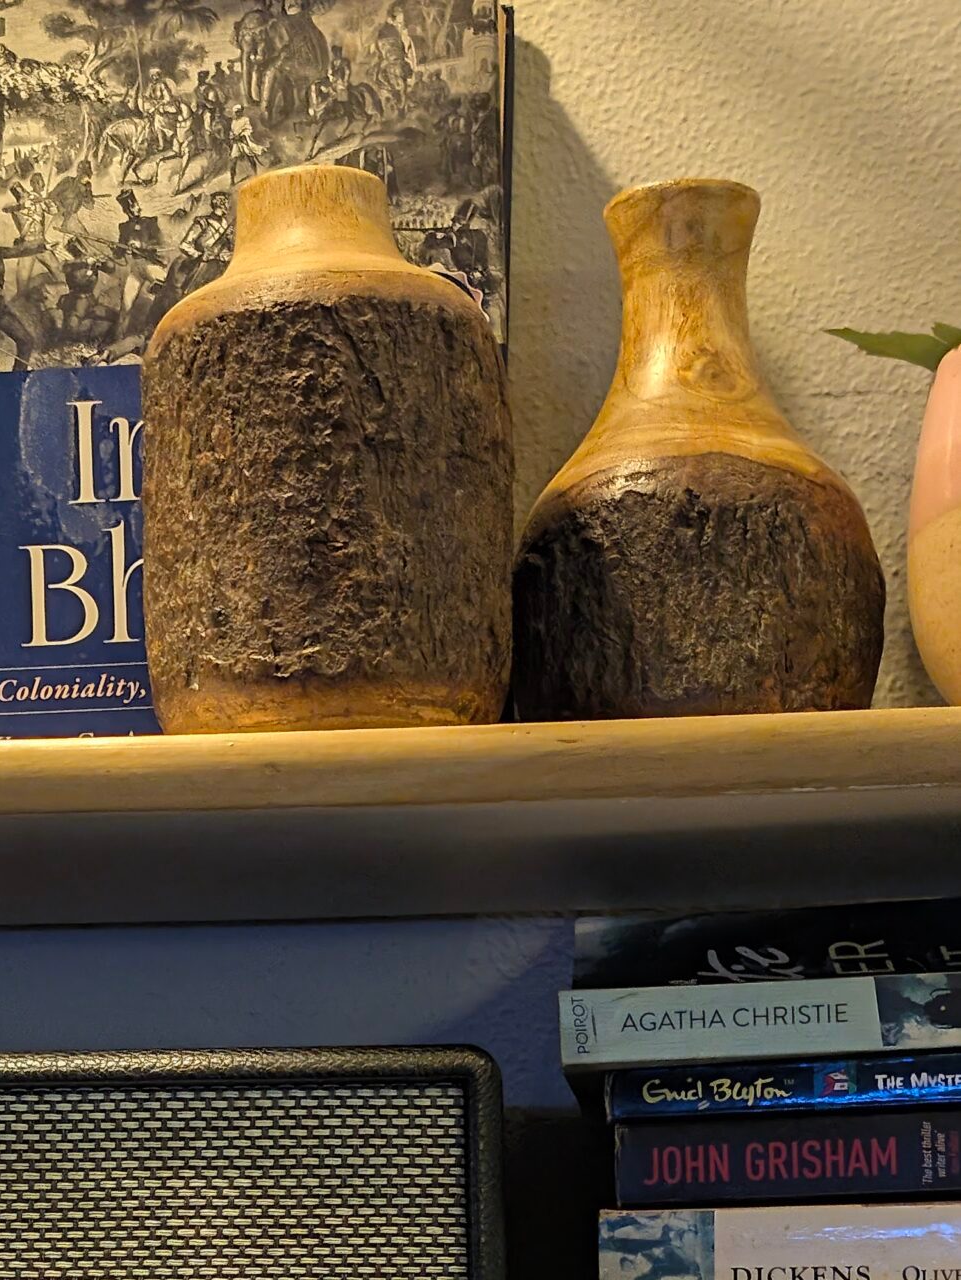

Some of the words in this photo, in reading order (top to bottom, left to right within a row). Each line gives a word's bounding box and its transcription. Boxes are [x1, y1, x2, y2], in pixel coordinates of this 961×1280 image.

[571, 996, 591, 1055] POIROT
[621, 1007, 726, 1033] AGATHA
[733, 1002, 849, 1028] CHRISTIE
[641, 1077, 704, 1105] Enid
[709, 1076, 793, 1106] Blyton
[643, 1143, 730, 1186] JOHN
[745, 1135, 899, 1181] GRISHAM
